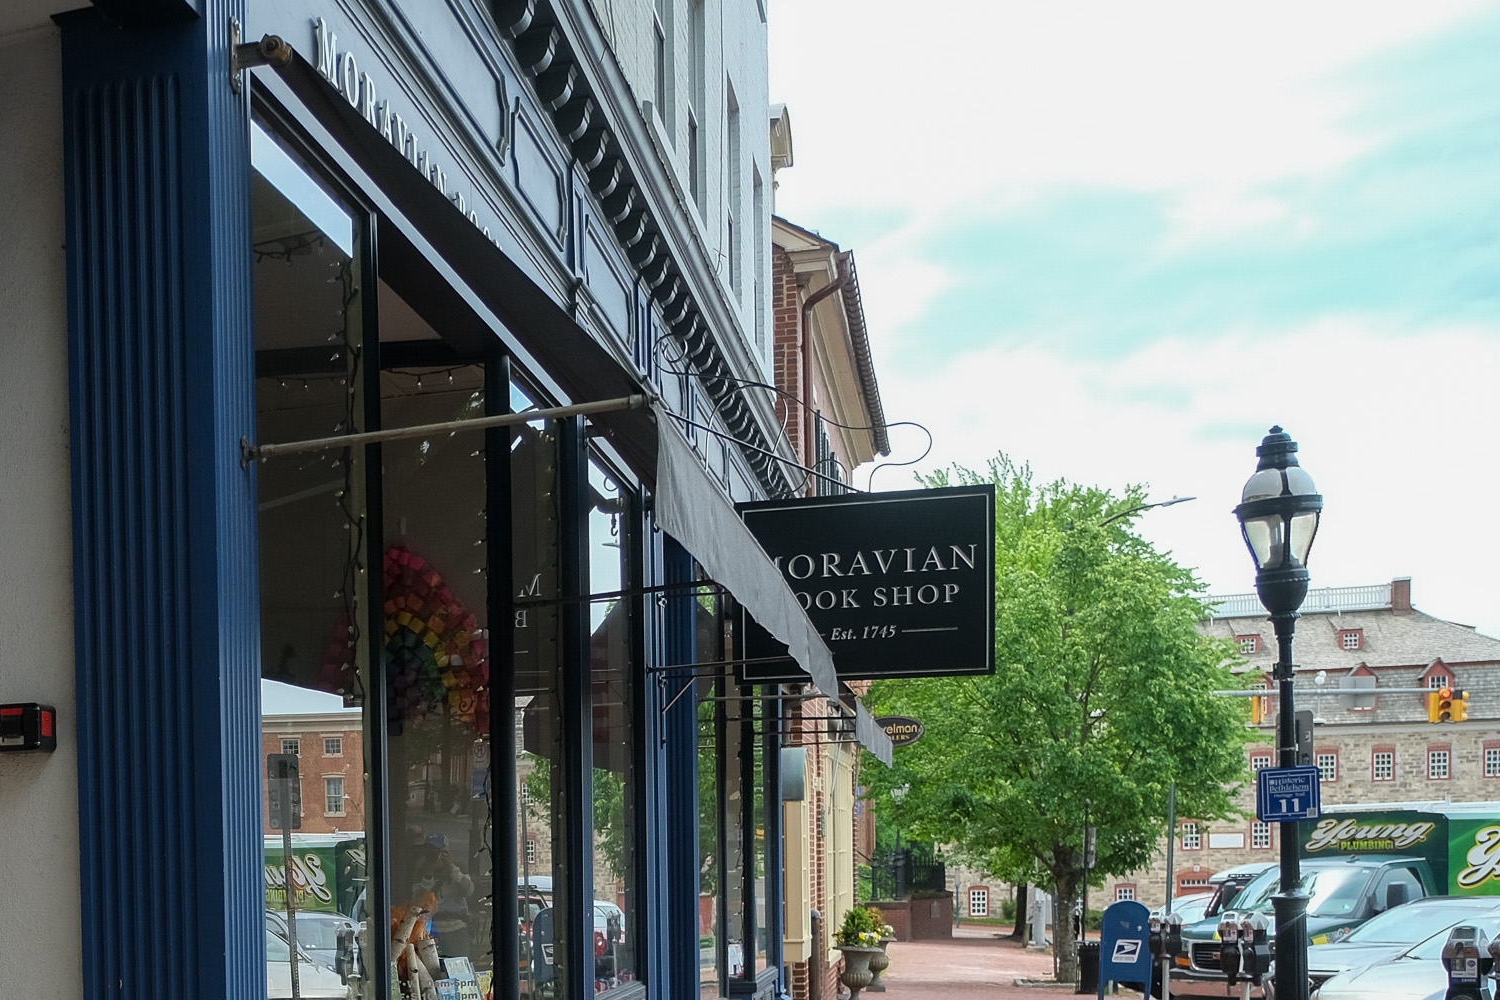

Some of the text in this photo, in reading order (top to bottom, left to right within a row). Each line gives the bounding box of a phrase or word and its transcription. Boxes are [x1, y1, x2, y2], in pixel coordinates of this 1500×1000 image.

[316, 16, 447, 197] MORAVIAN
[773, 544, 977, 580] ORAVIAN
[795, 583, 960, 611] OOK SHOP
[831, 624, 897, 641] Est. 1745
[1279, 798, 1299, 813] 11
[1305, 819, 1436, 852] Young
[1341, 840, 1393, 851] PLUMBING
